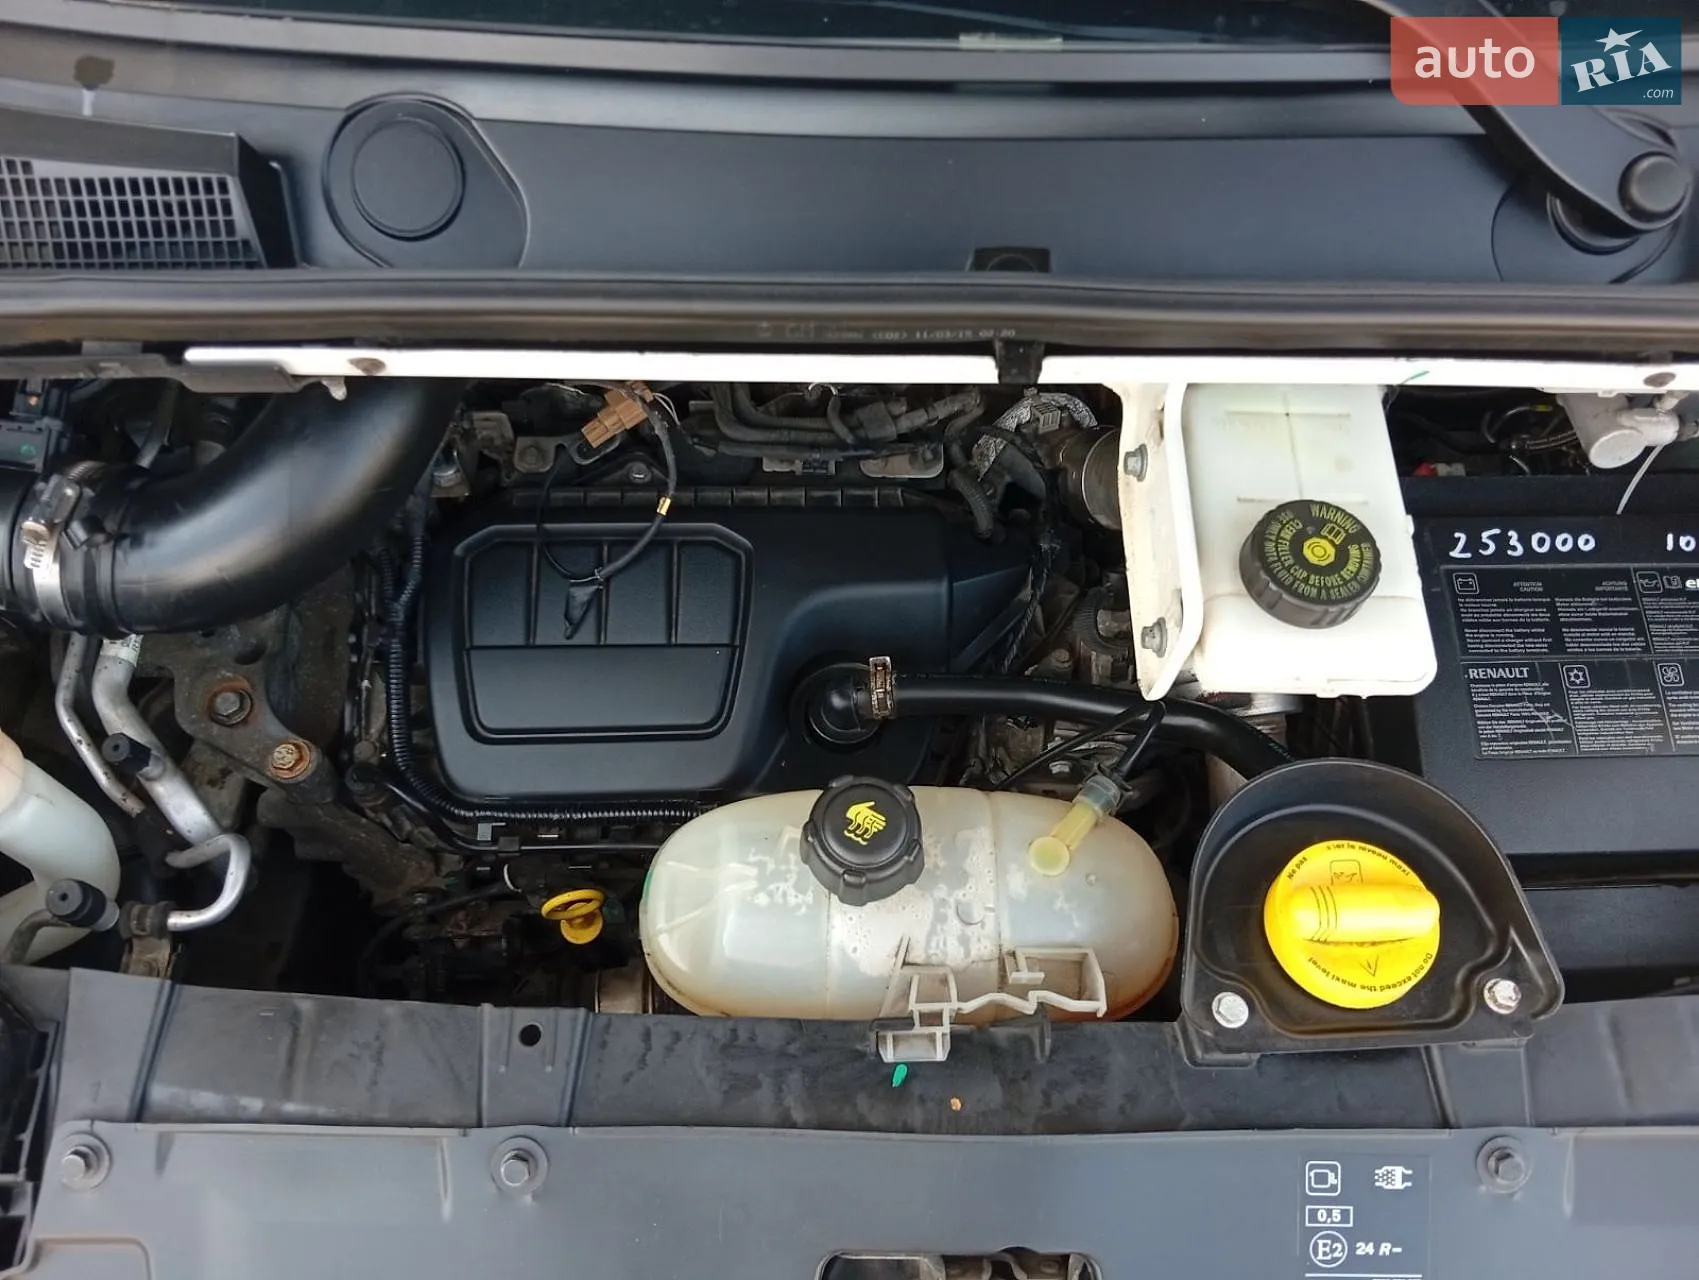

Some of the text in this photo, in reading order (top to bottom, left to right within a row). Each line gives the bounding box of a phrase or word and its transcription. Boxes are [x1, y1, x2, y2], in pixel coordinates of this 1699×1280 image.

[1310, 503, 1361, 534] WARNING
[1449, 528, 1596, 557] 253000
[1277, 539, 1294, 566] FILLER
[1290, 565, 1308, 581] CAP
[1309, 573, 1344, 587] BEFORE
[1269, 562, 1294, 585] FLUID
[1292, 581, 1318, 598] FROM
[1320, 590, 1327, 600] A
[1468, 667, 1530, 680] RENAULT
[1294, 856, 1308, 873] pas
[1358, 845, 1388, 861] niveau
[1389, 858, 1410, 877] maxi
[1308, 952, 1433, 992] Do not exceed the maxi level
[1317, 1209, 1341, 1224] 0,5
[1316, 1239, 1344, 1260] E2
[1355, 1242, 1375, 1256] 24
